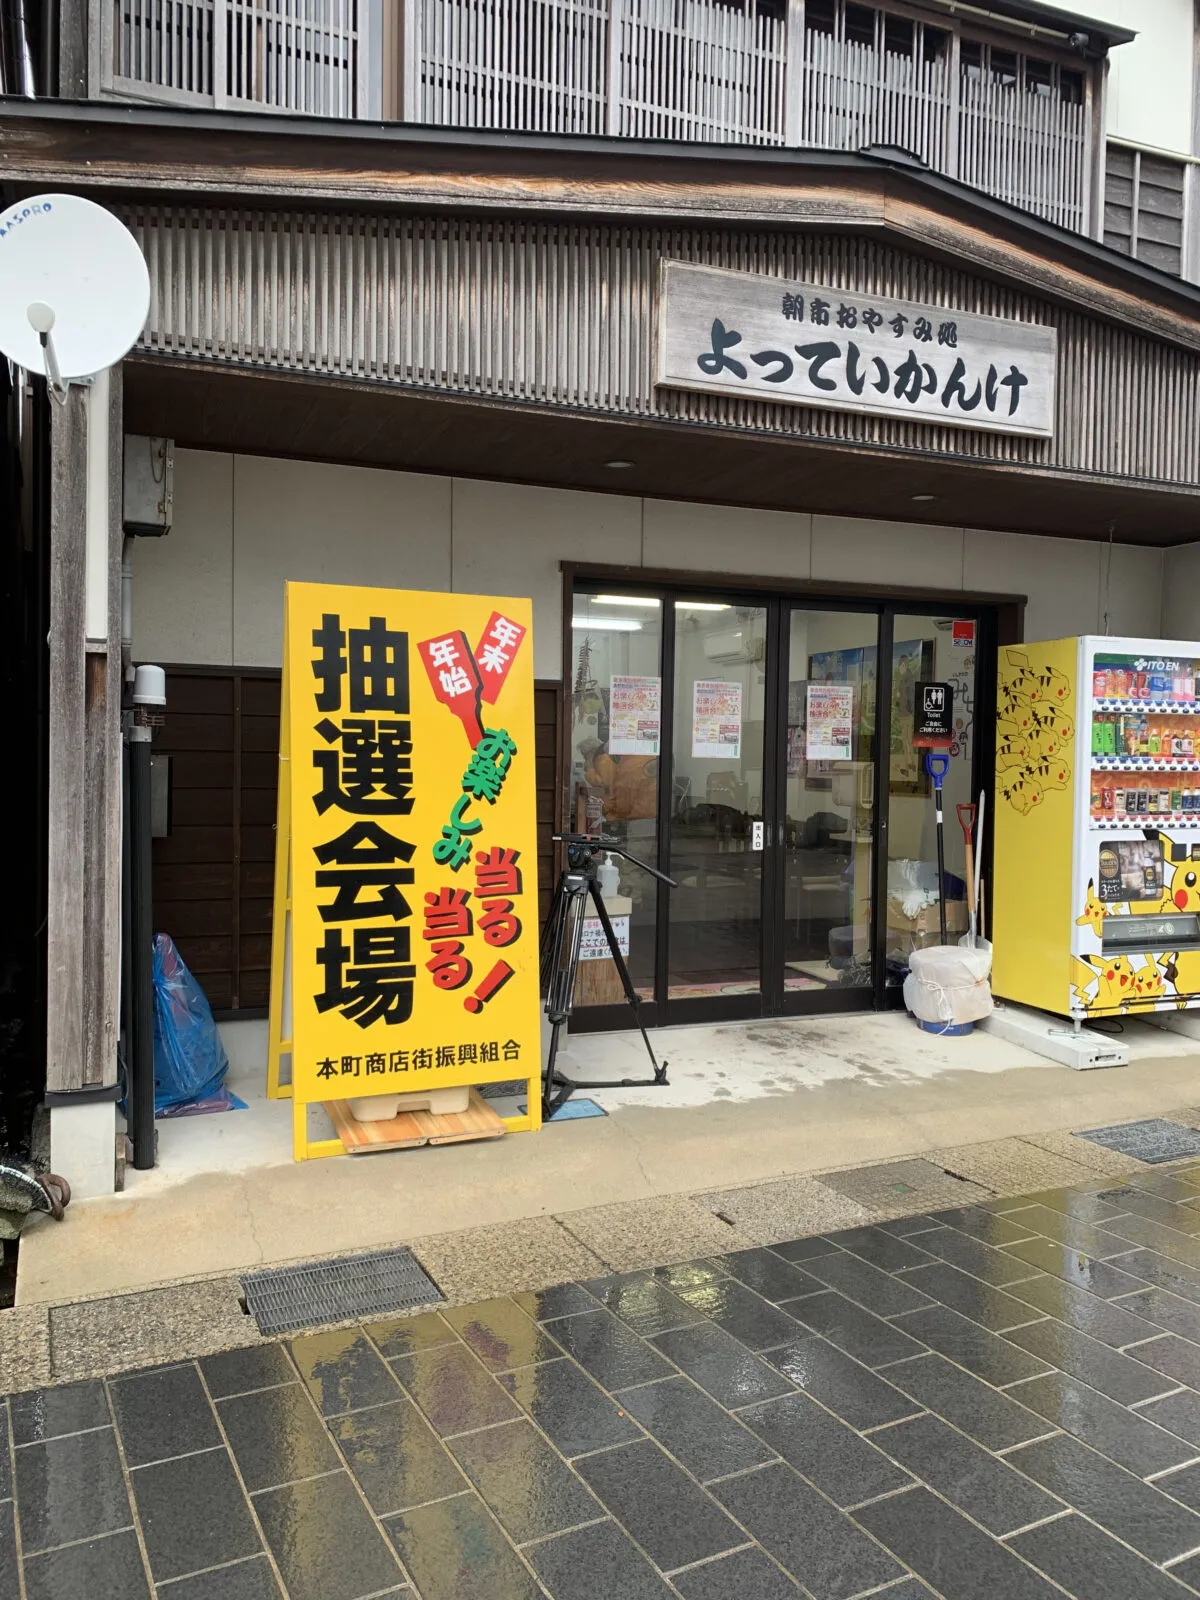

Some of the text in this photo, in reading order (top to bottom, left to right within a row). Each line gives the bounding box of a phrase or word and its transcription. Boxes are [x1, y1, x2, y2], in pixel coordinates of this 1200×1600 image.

[782, 292, 957, 348] 朝市おやすみ処
[697, 318, 1029, 416] よっていかんけ
[428, 638, 472, 697] 年始
[478, 617, 521, 674] 年末
[311, 613, 417, 1029] 抽選会場
[432, 728, 517, 873] お楽しみ
[316, 1039, 521, 1080] 本町商店街振興組合
